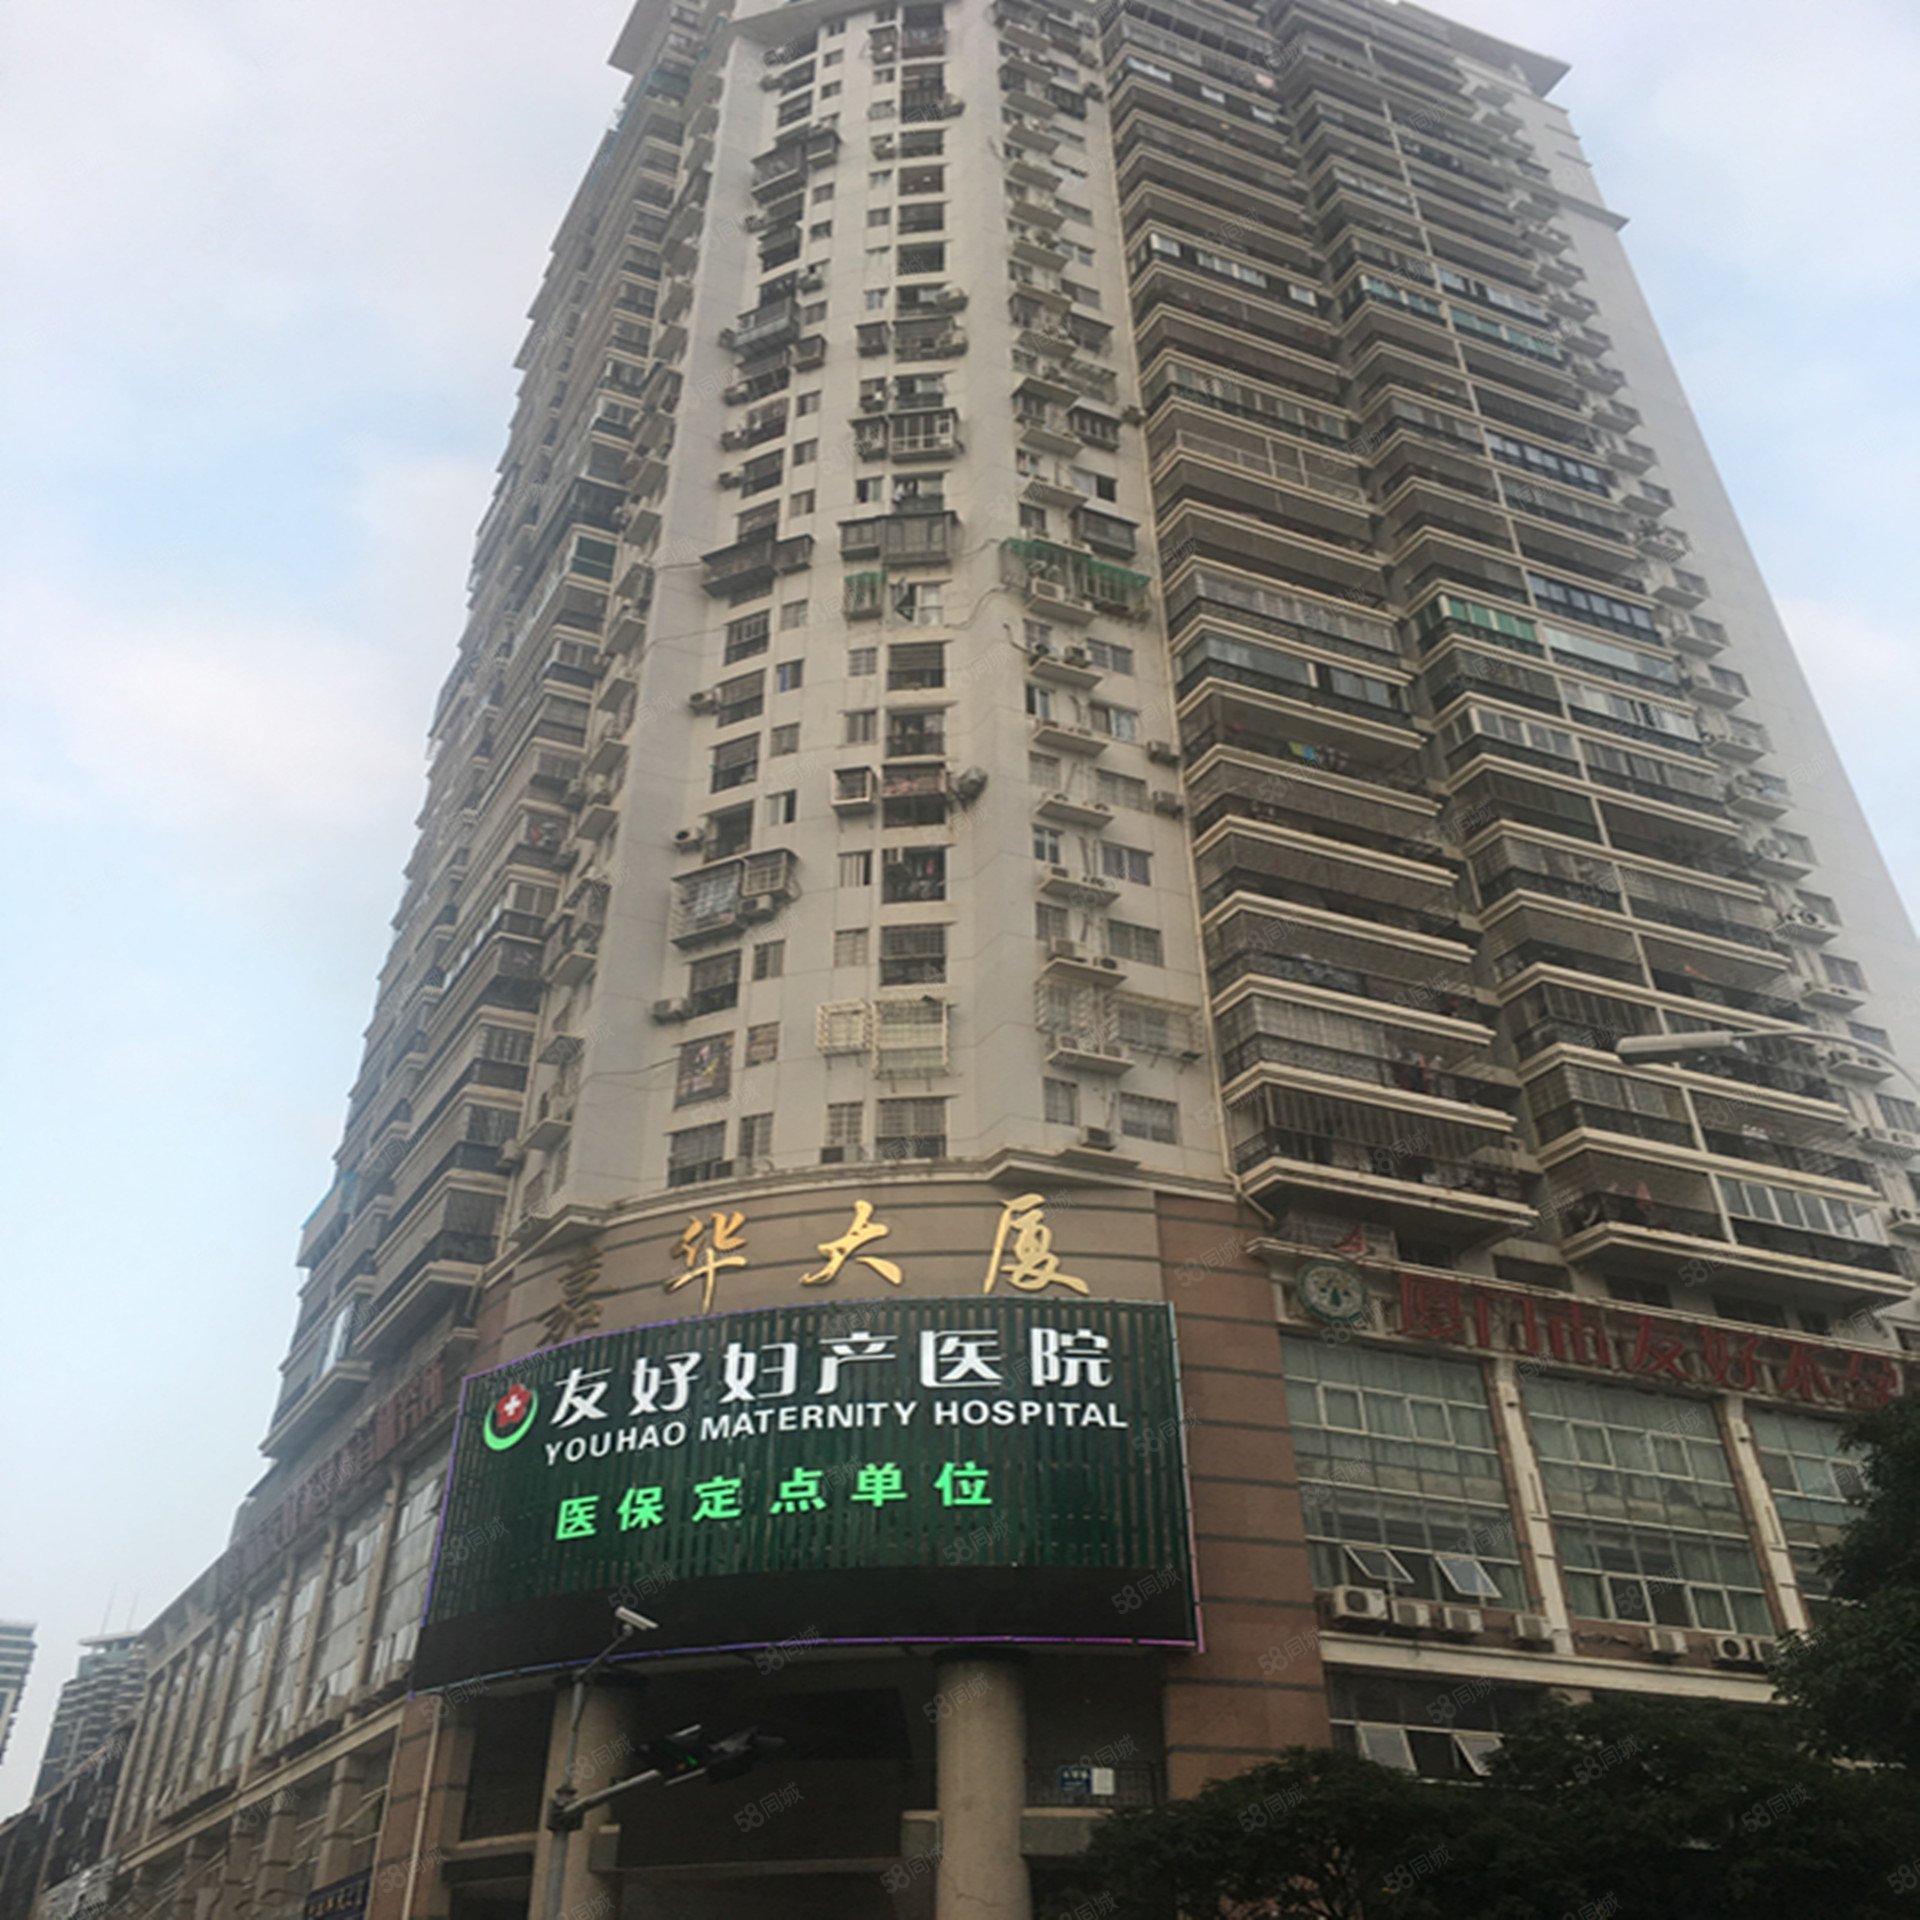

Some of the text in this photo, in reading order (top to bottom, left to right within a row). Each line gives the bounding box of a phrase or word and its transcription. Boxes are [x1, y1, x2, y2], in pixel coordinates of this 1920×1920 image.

[551, 1327, 1113, 1428] 友好妇产医院
[546, 1400, 1129, 1466] YOUHAO MATERNITY HOSPITAL
[555, 1461, 992, 1541] 医保定点单位
